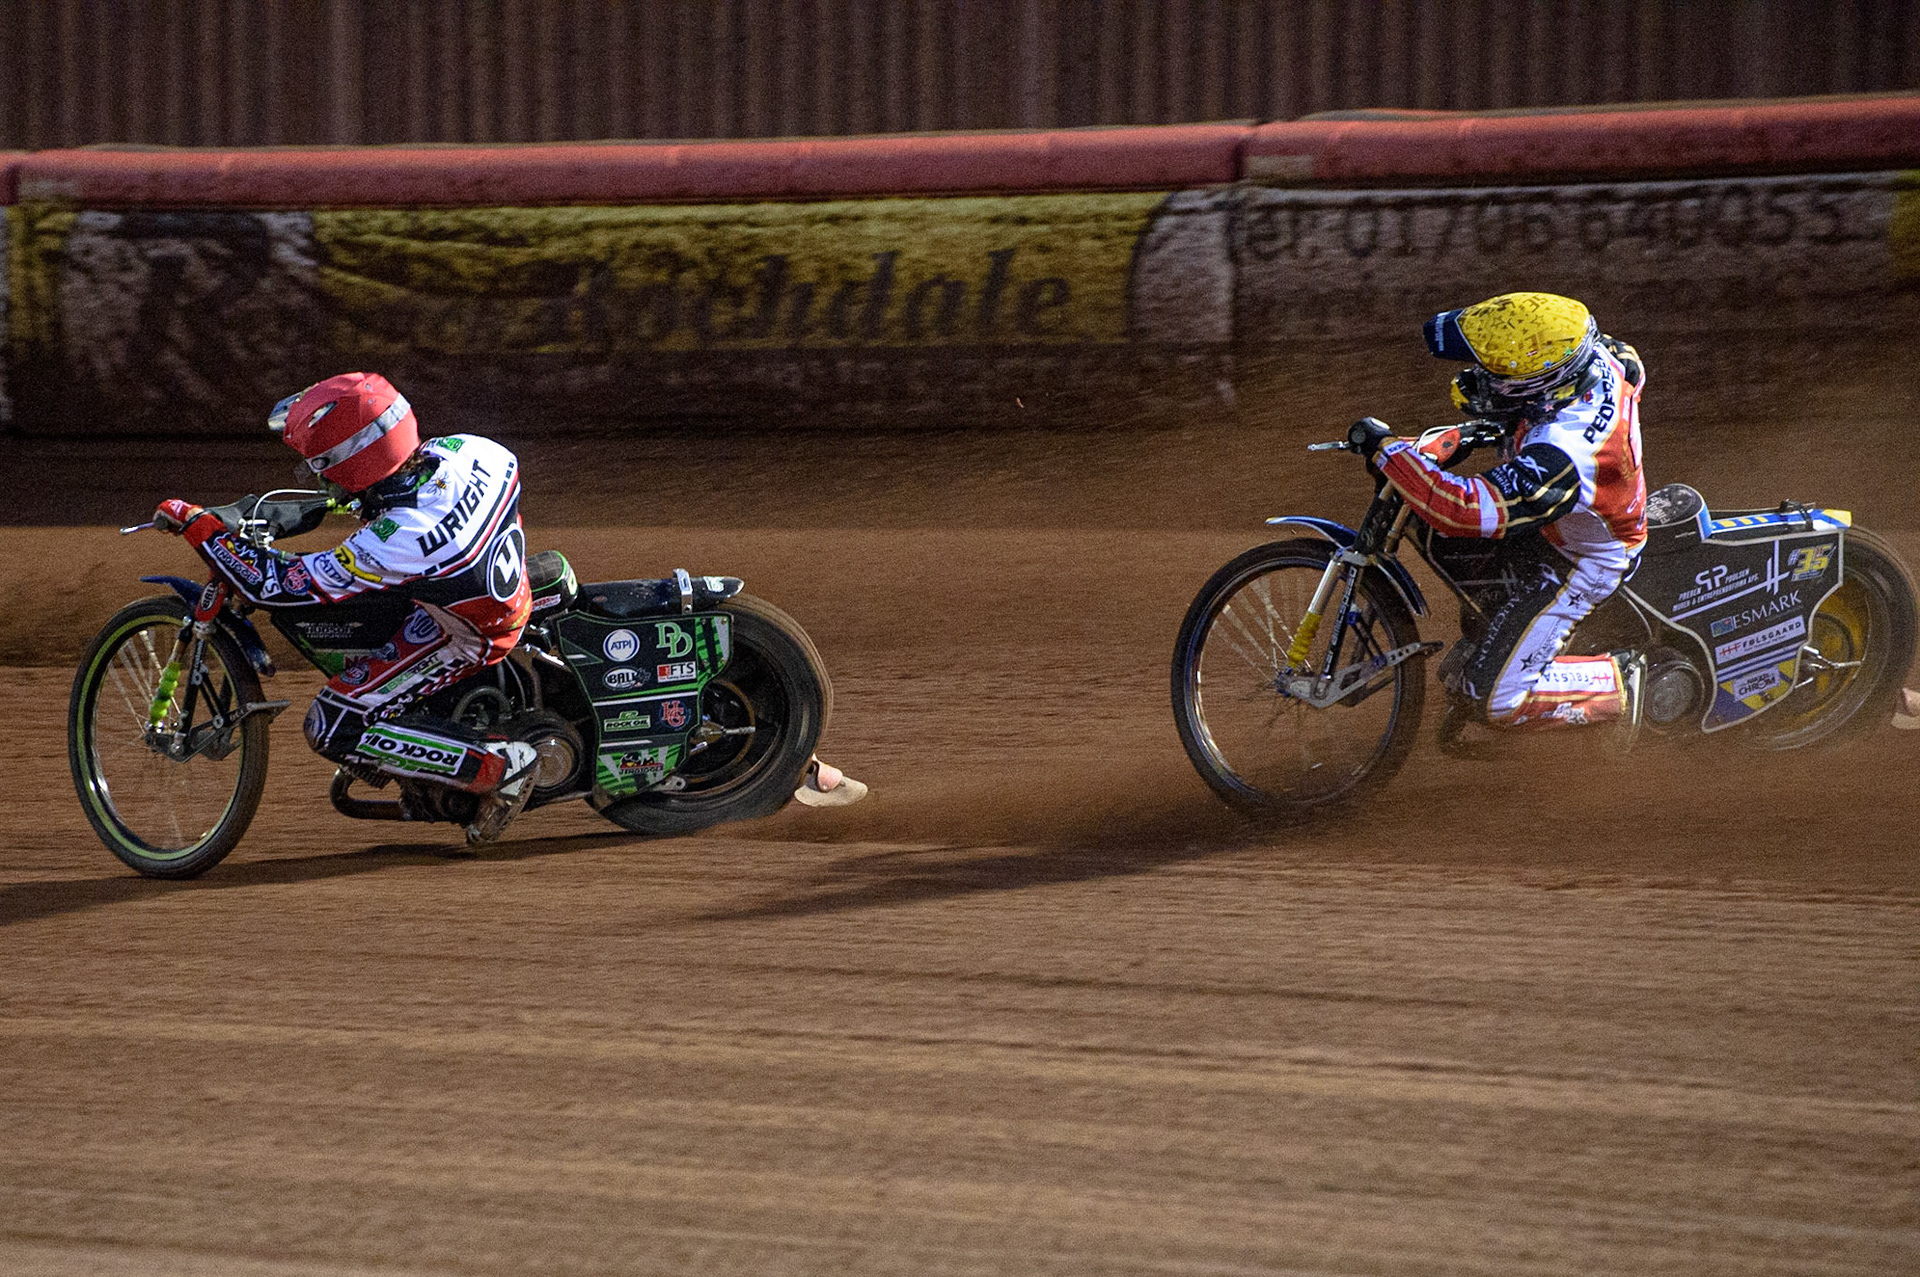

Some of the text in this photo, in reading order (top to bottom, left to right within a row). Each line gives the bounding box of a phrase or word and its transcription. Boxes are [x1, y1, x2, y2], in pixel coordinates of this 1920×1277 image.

[416, 459, 491, 557] WRIGHT
[1733, 590, 1802, 629] ESMARK
[610, 640, 632, 651] ATPI
[670, 662, 694, 675] FTS
[606, 720, 632, 728] ROCK
[365, 733, 460, 766] ROCK OIL
